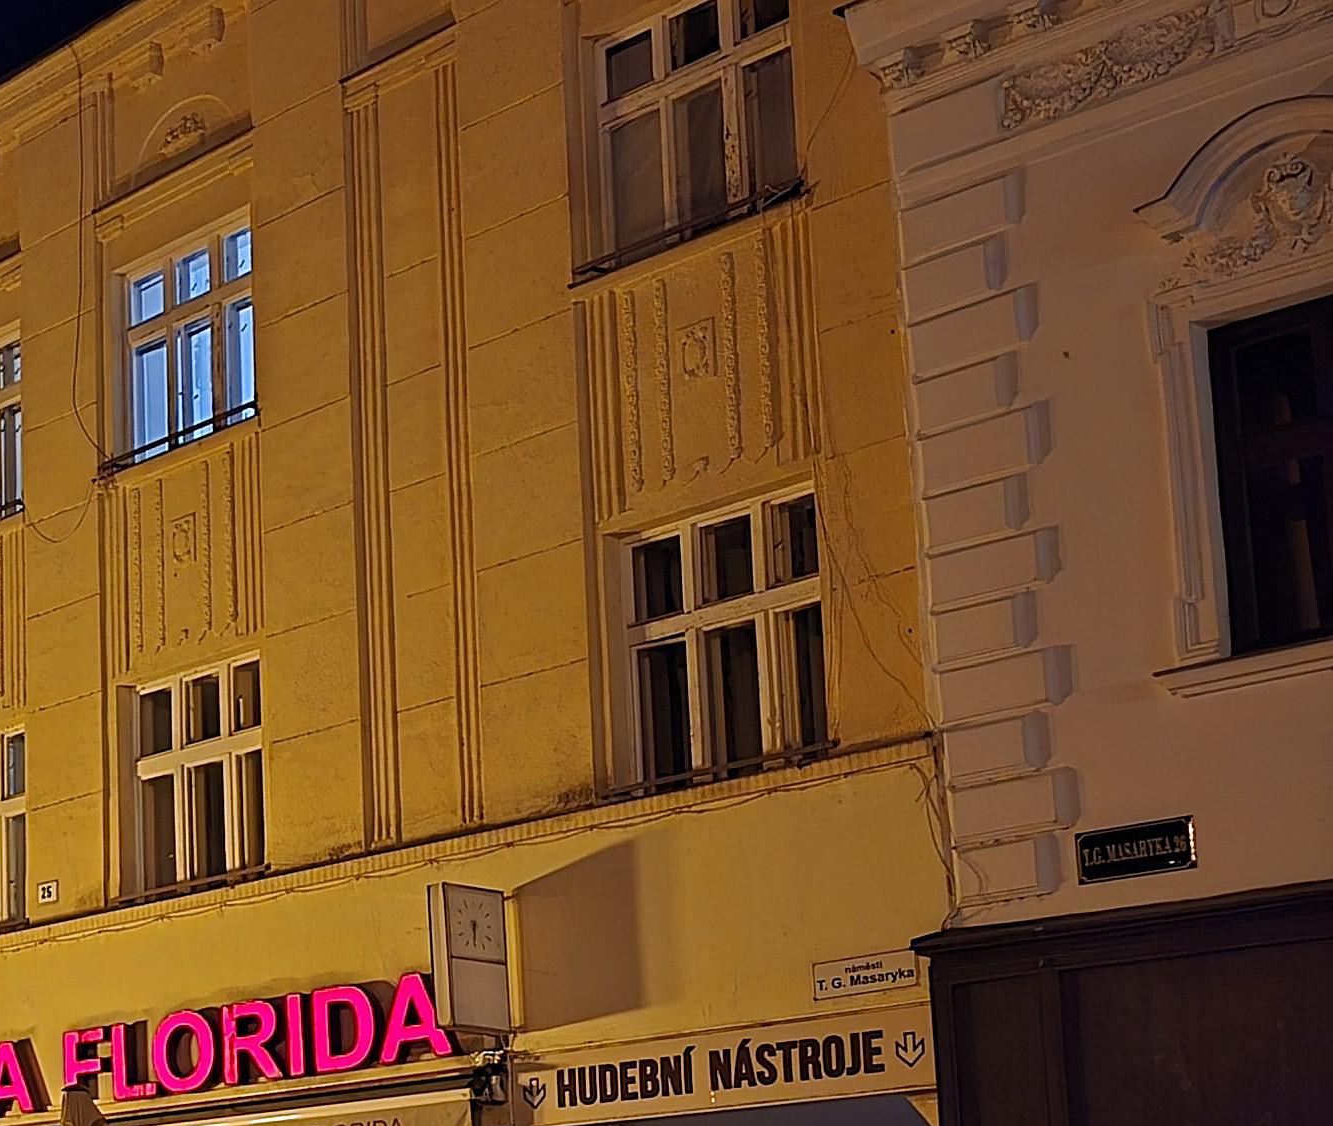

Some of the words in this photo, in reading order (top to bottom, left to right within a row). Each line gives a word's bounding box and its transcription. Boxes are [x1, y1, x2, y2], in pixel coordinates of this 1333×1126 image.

[41, 885, 52, 899] 25
[817, 979, 828, 991] T.
[831, 977, 846, 989] G.
[849, 967, 915, 987] Masaryka
[62, 970, 454, 1102] FLORIDA
[556, 1045, 696, 1108] HUDEBNÍ
[709, 1029, 886, 1092] NÁSTROJE
